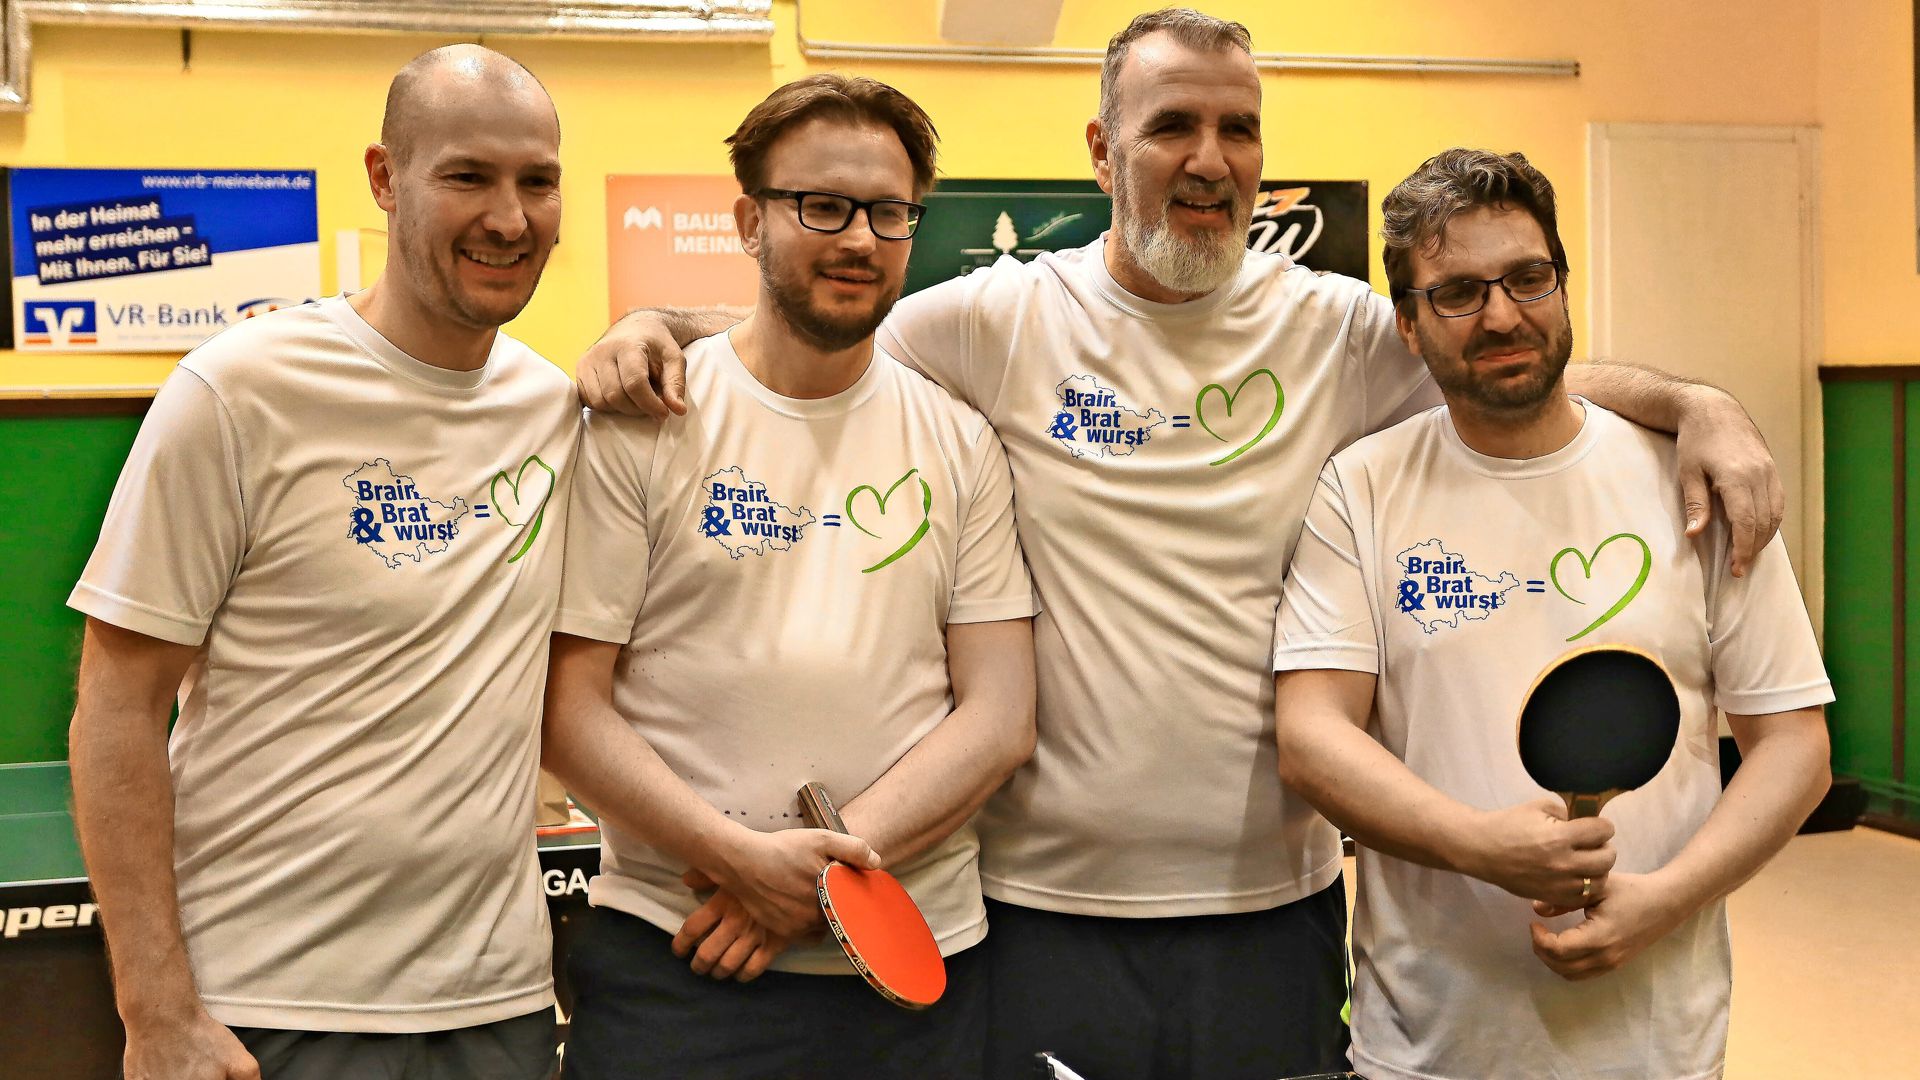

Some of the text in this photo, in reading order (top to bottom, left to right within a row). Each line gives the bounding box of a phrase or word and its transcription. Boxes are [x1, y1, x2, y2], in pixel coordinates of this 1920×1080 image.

[142, 173, 312, 190] www.vrb-meinebank.de
[31, 201, 160, 232] In der Heimat
[673, 213, 735, 231] BAUS
[36, 233, 86, 257] mehr
[88, 225, 180, 250] erreichen
[40, 243, 208, 281] Mit Ihnen. Für Sie!
[107, 303, 228, 327] VR-Bank
[1080, 408, 1121, 429] Brat
[1086, 427, 1145, 445] wurst
[380, 502, 430, 523] Brat
[731, 502, 777, 523] Brat
[392, 520, 455, 541] wurst
[740, 521, 799, 542] wurst
[1426, 576, 1473, 594] Brat
[1435, 592, 1499, 610] wurst
